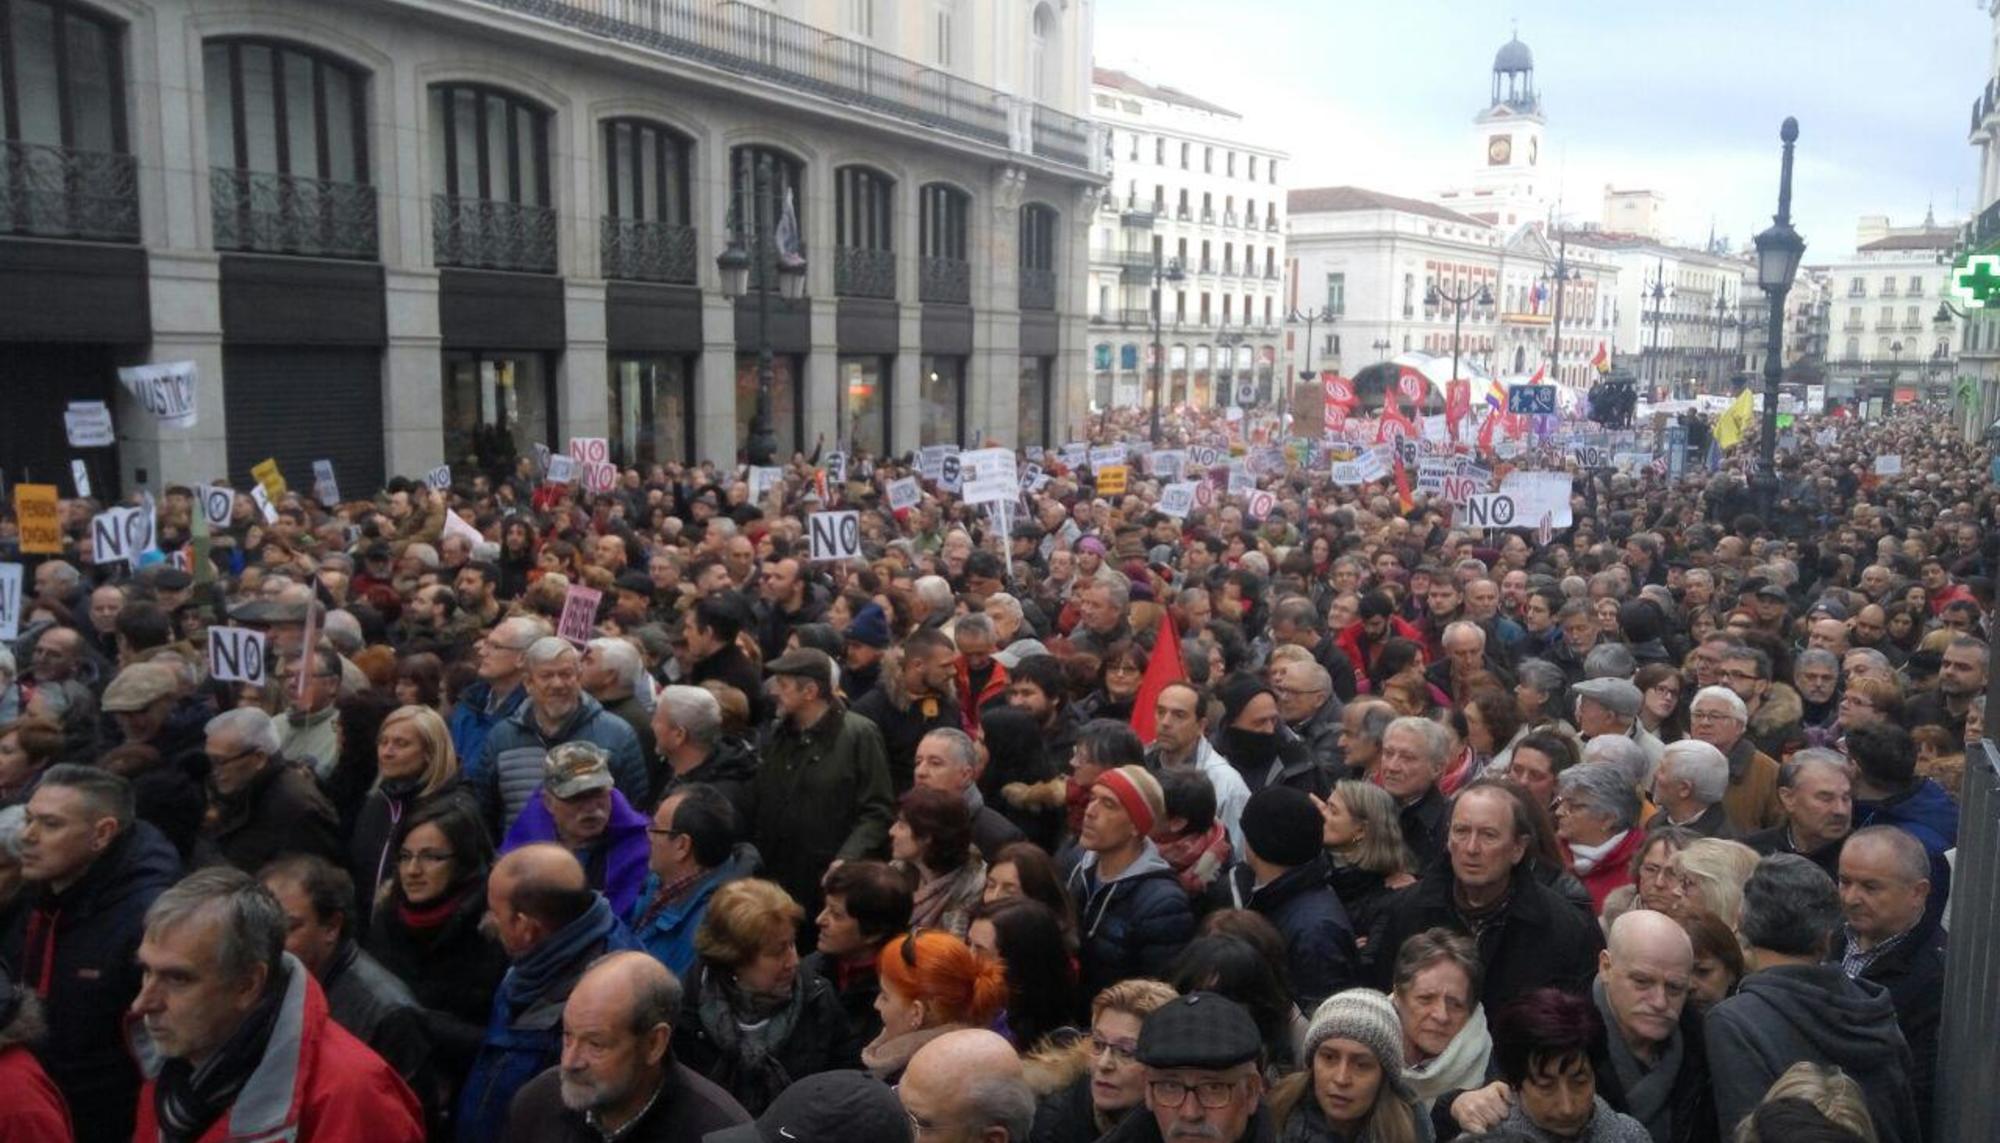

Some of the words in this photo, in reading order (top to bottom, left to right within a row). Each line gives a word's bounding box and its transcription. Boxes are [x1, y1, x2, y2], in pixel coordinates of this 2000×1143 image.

[571, 440, 604, 462] NO
[1444, 475, 1476, 503] NO
[1469, 495, 1515, 525] NO
[95, 510, 152, 560] NO
[812, 514, 857, 557] NO
[212, 630, 262, 681] NO
